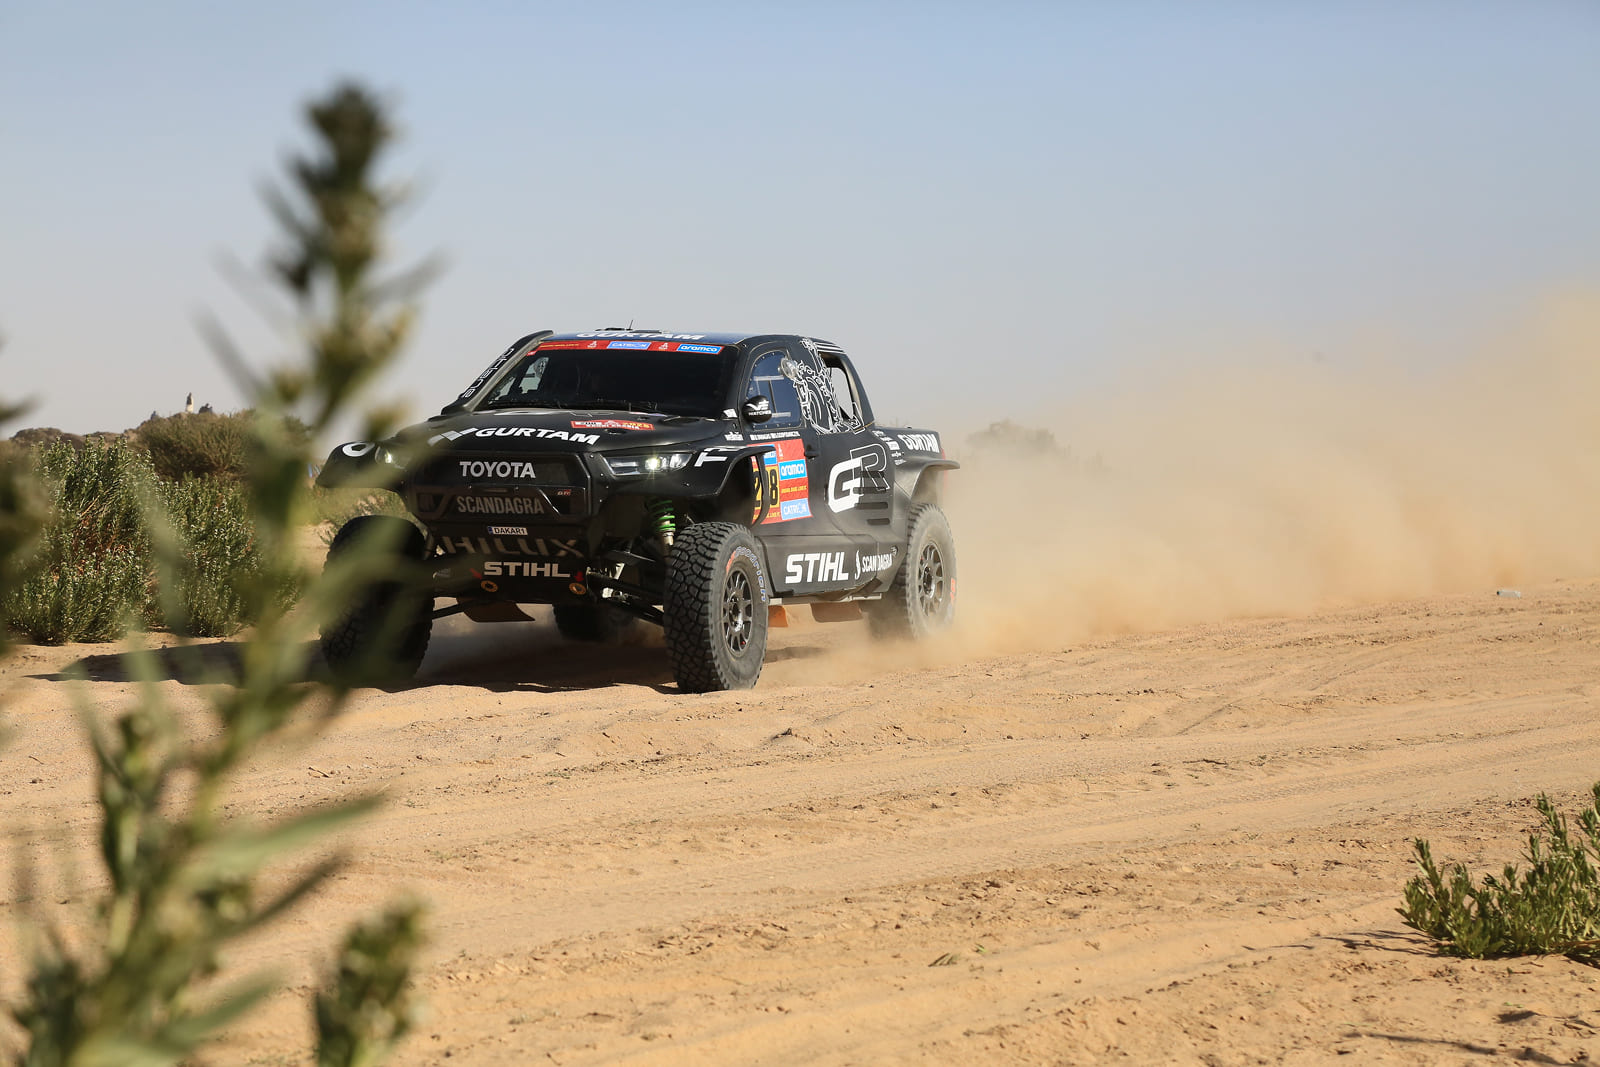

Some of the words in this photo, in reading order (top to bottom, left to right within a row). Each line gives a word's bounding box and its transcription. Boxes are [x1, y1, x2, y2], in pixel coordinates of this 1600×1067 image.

[475, 427, 600, 445] GURTAM
[459, 461, 536, 479] TOYOTA
[781, 465, 805, 477] aramco
[456, 496, 545, 514] SCANDAGRA
[494, 527, 525, 535] DAKAR1
[442, 536, 584, 558] HILUX
[483, 561, 571, 578] STIHL
[785, 551, 849, 584] STIHL
[862, 553, 893, 573] SCANDAGRA
